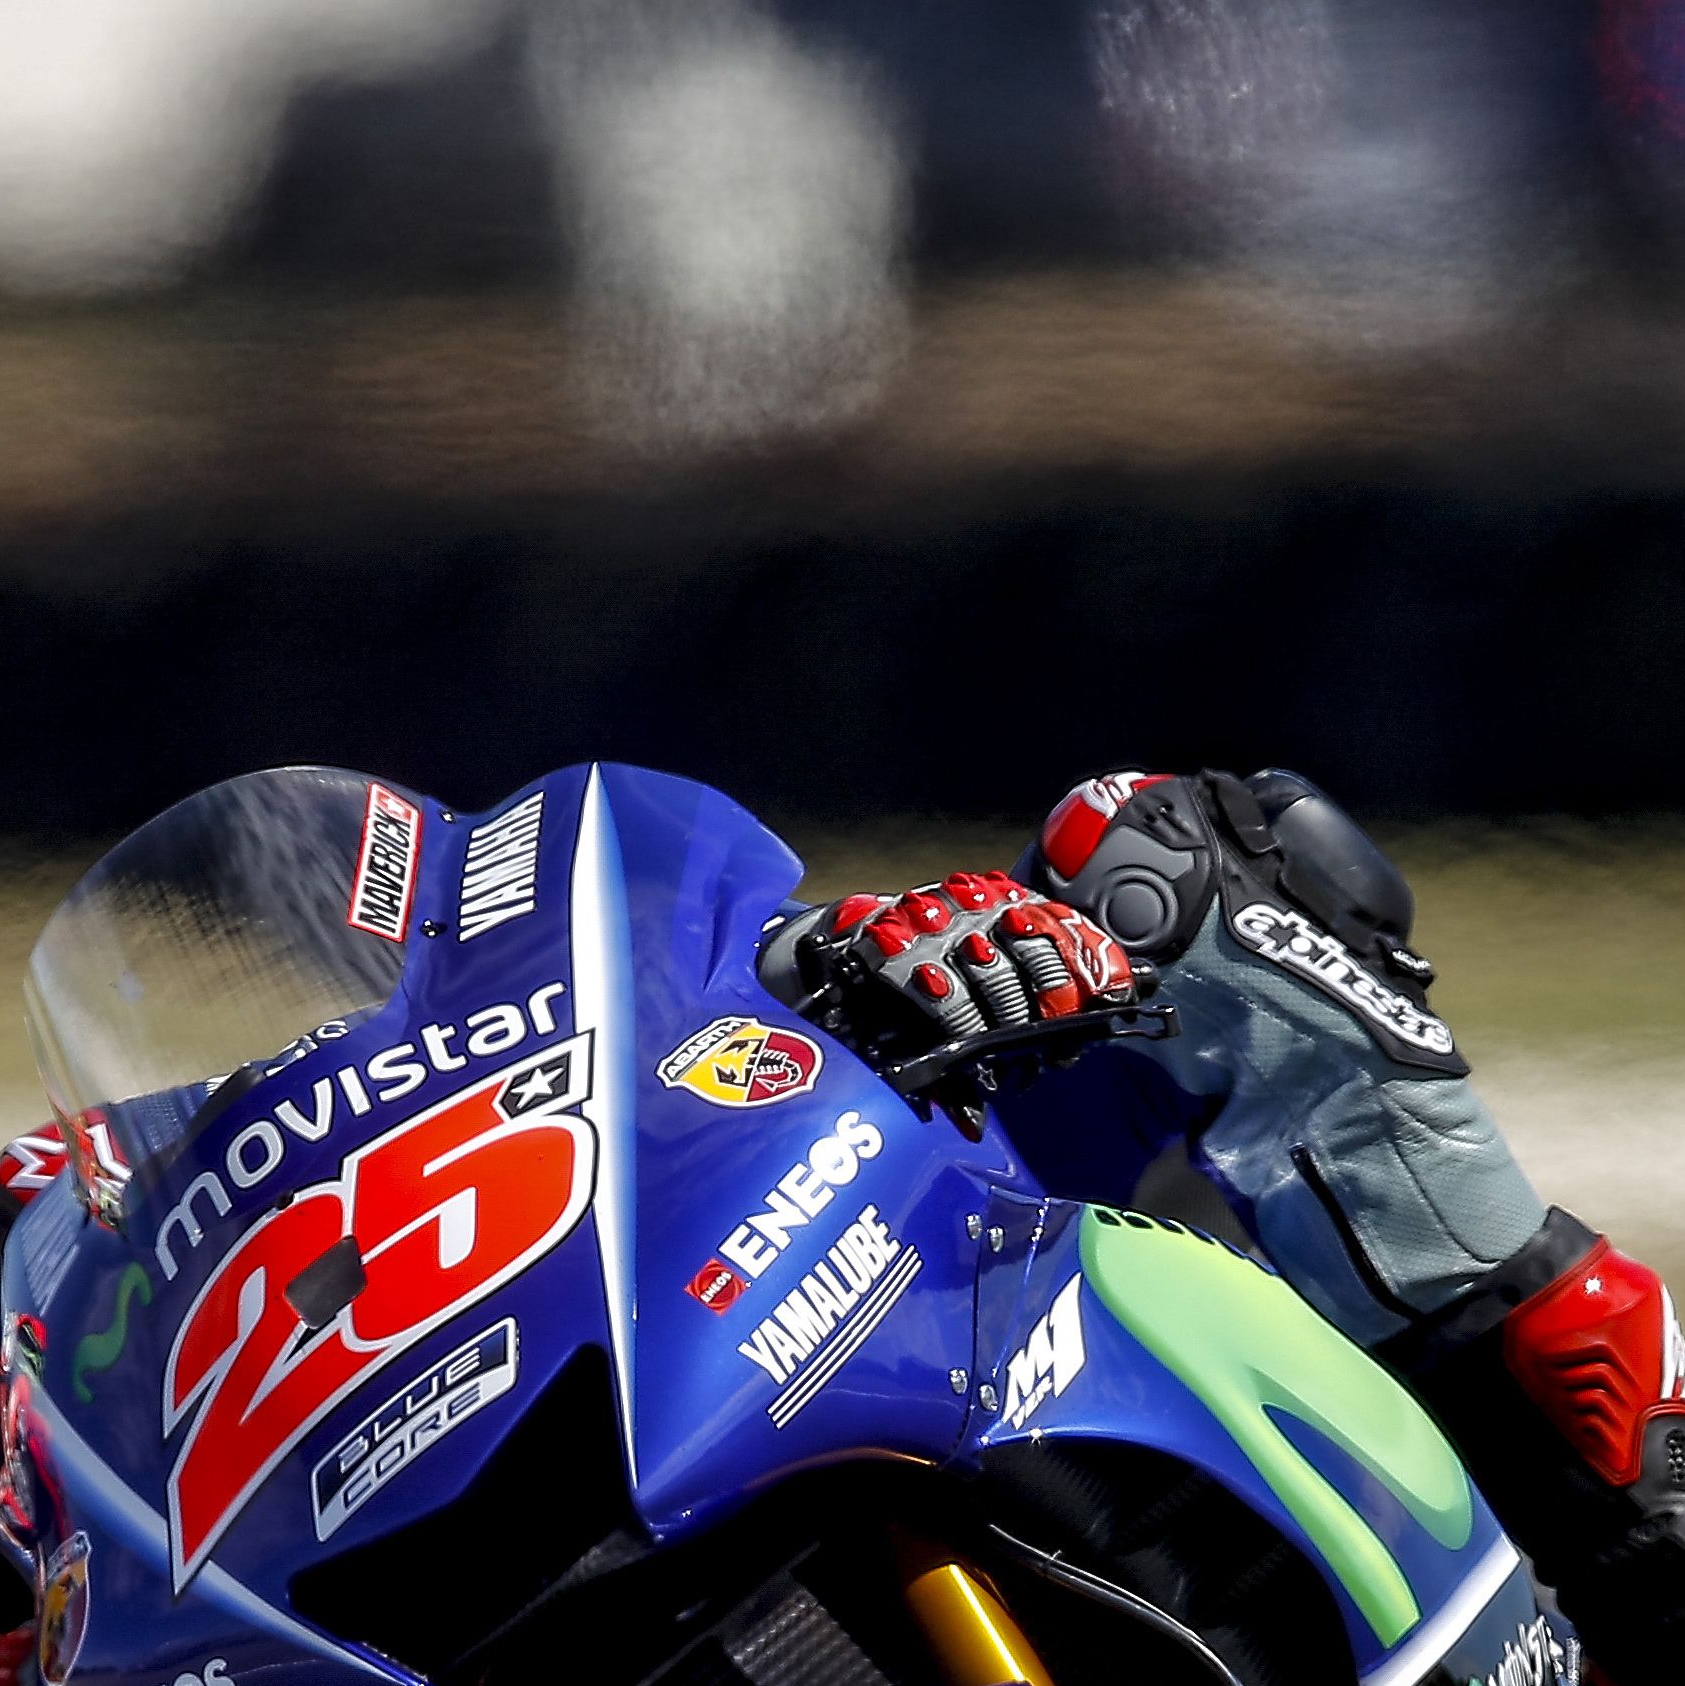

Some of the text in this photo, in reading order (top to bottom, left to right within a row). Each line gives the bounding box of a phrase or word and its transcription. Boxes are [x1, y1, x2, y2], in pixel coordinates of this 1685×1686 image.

[358, 805, 410, 933] MAVERICK
[459, 791, 544, 942] YAMAHA
[666, 1021, 742, 1077] ABARTH
[154, 981, 565, 1281] movistar
[717, 1110, 884, 1279] ENEOS
[164, 1030, 599, 1596] 25
[700, 1271, 732, 1303] ENEOS
[736, 1203, 901, 1386] YAMALUBE
[338, 1348, 481, 1474] BLUE
[343, 1382, 481, 1510] CORE
